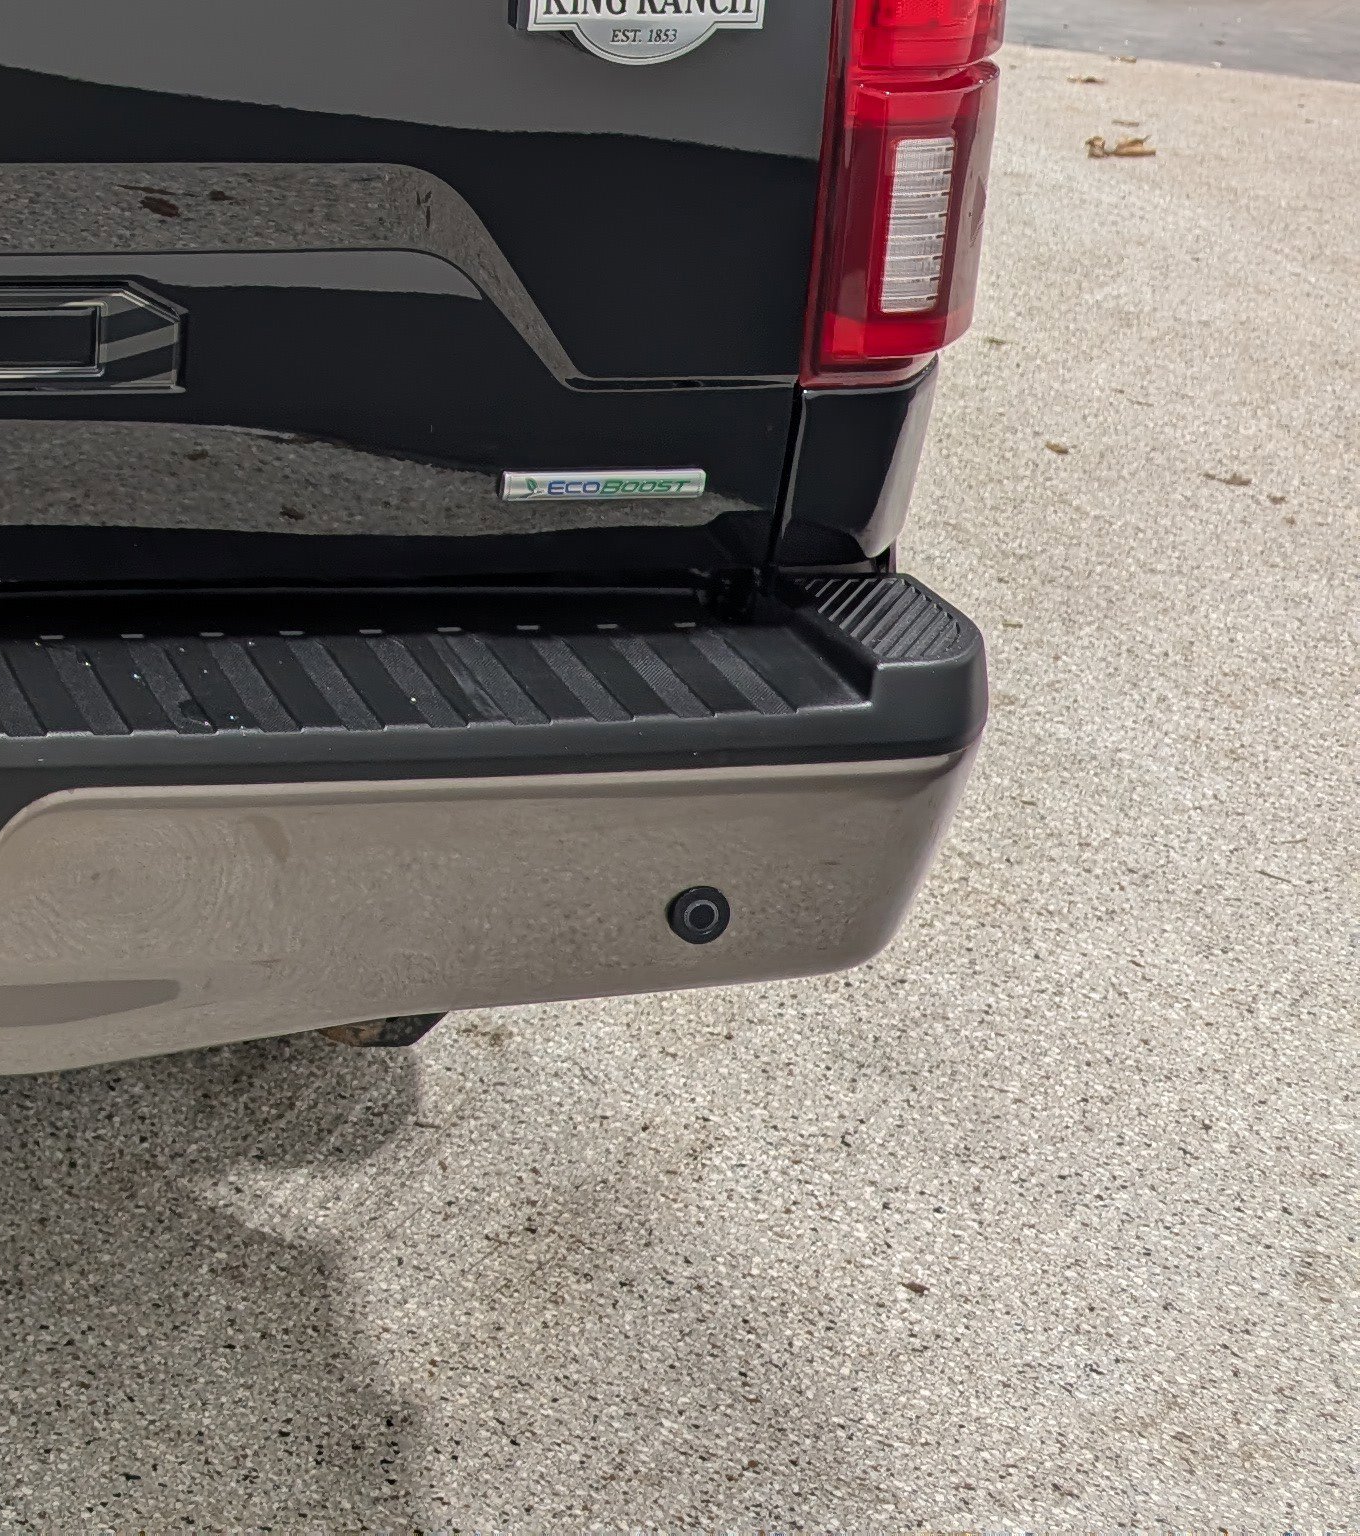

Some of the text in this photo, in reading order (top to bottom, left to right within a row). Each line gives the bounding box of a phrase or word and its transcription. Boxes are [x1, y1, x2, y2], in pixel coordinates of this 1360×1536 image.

[610, 28, 678, 43] EST. 1853
[547, 478, 691, 496] ECOBOOST
